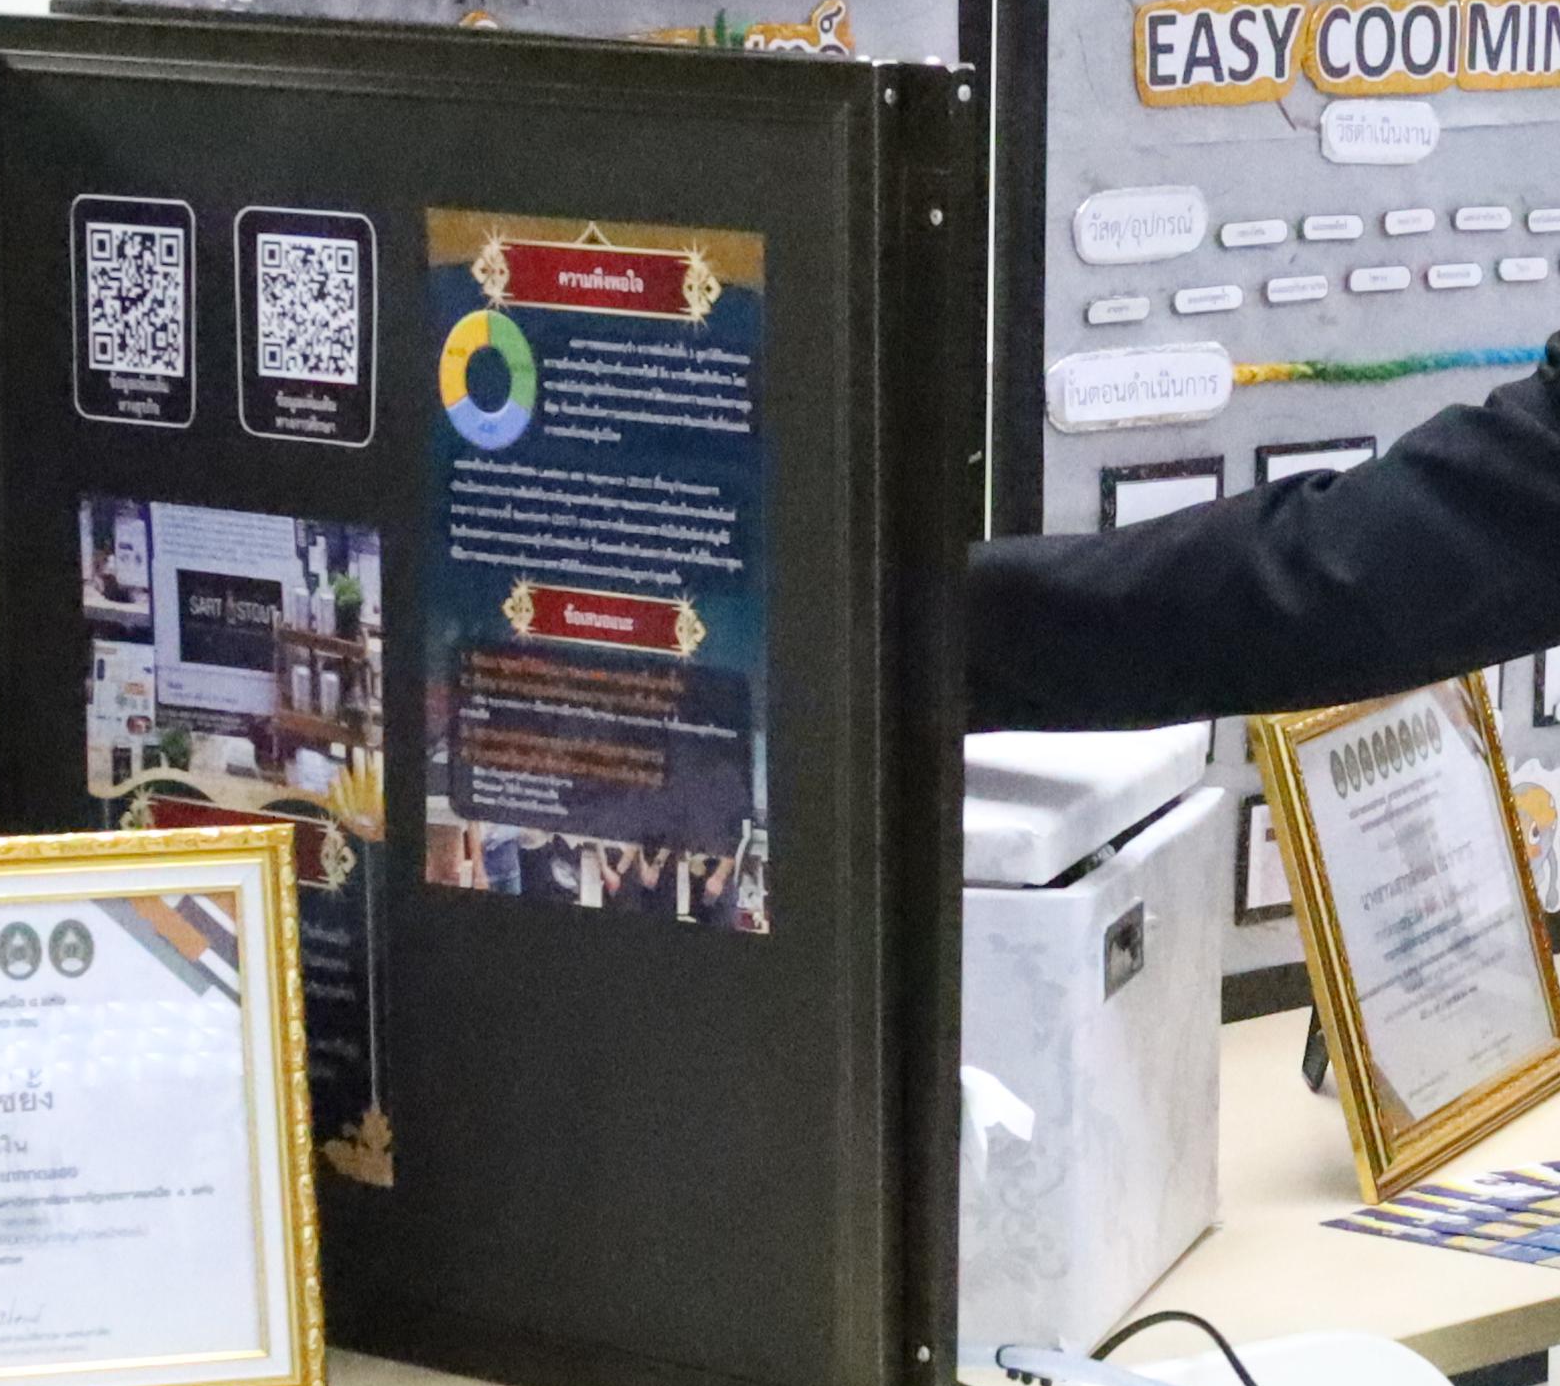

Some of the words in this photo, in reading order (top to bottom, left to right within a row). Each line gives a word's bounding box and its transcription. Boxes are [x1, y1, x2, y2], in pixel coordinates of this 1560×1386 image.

[1148, 7, 1305, 86] EASY
[1088, 205, 1194, 250] วัสดุ/อุปกรณ์
